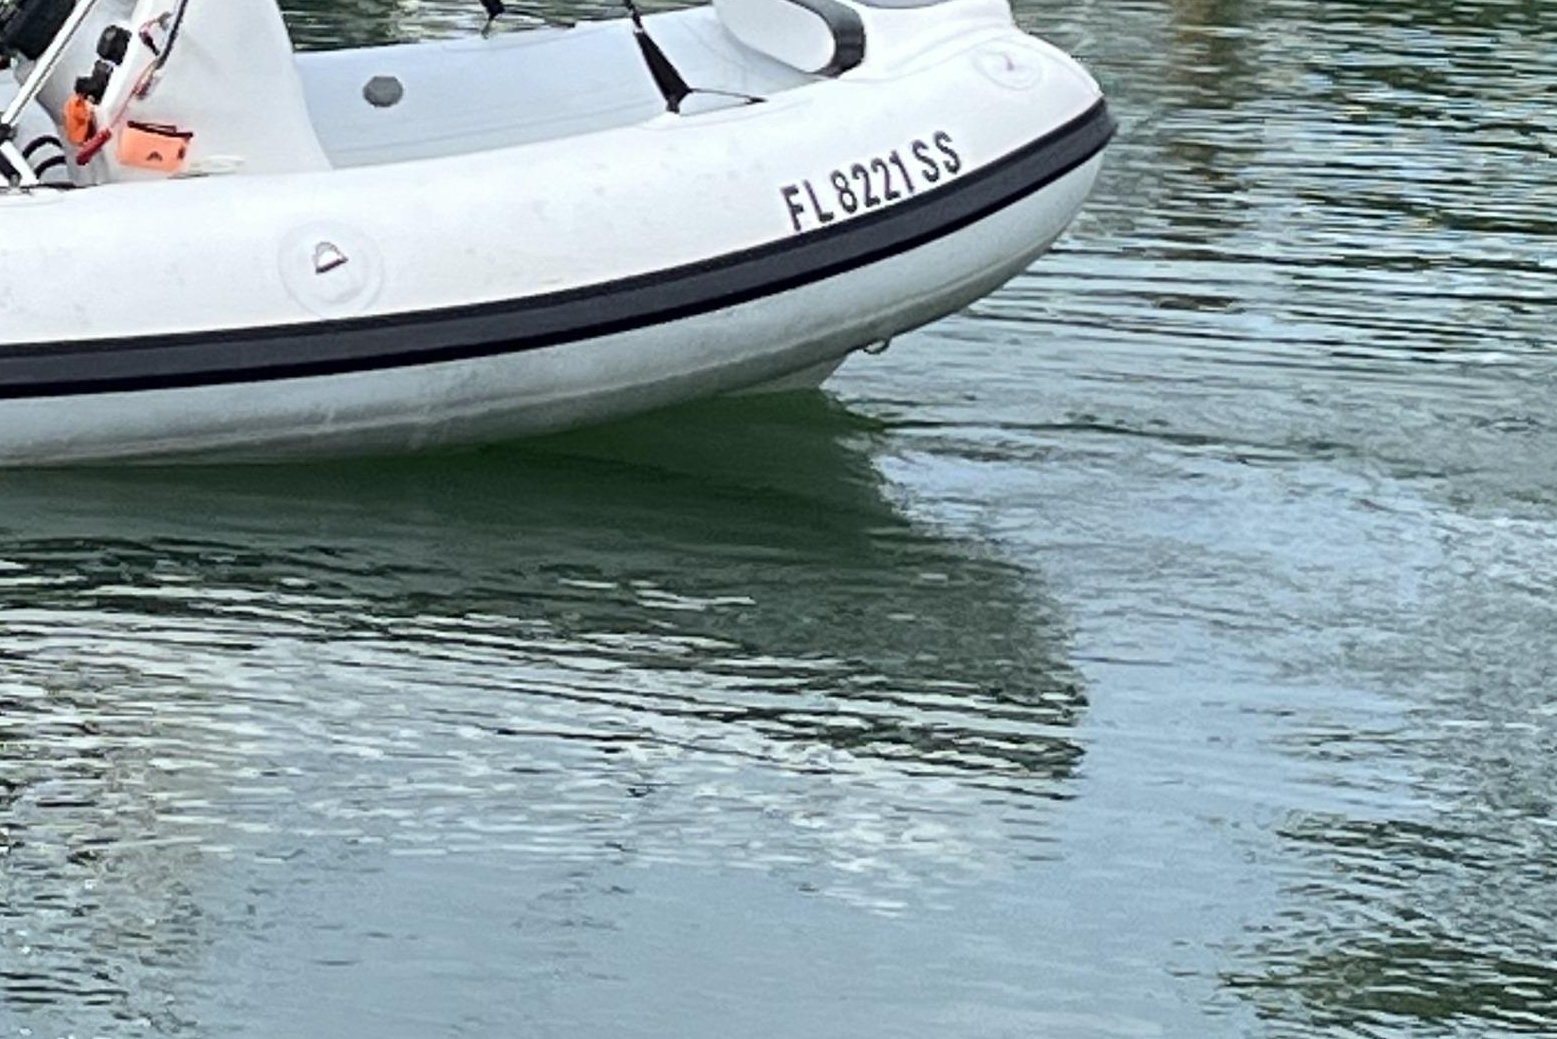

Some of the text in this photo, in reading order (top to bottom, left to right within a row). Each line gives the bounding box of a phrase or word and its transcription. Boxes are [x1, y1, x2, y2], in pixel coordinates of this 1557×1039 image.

[779, 130, 962, 232] FL 8221 SS
